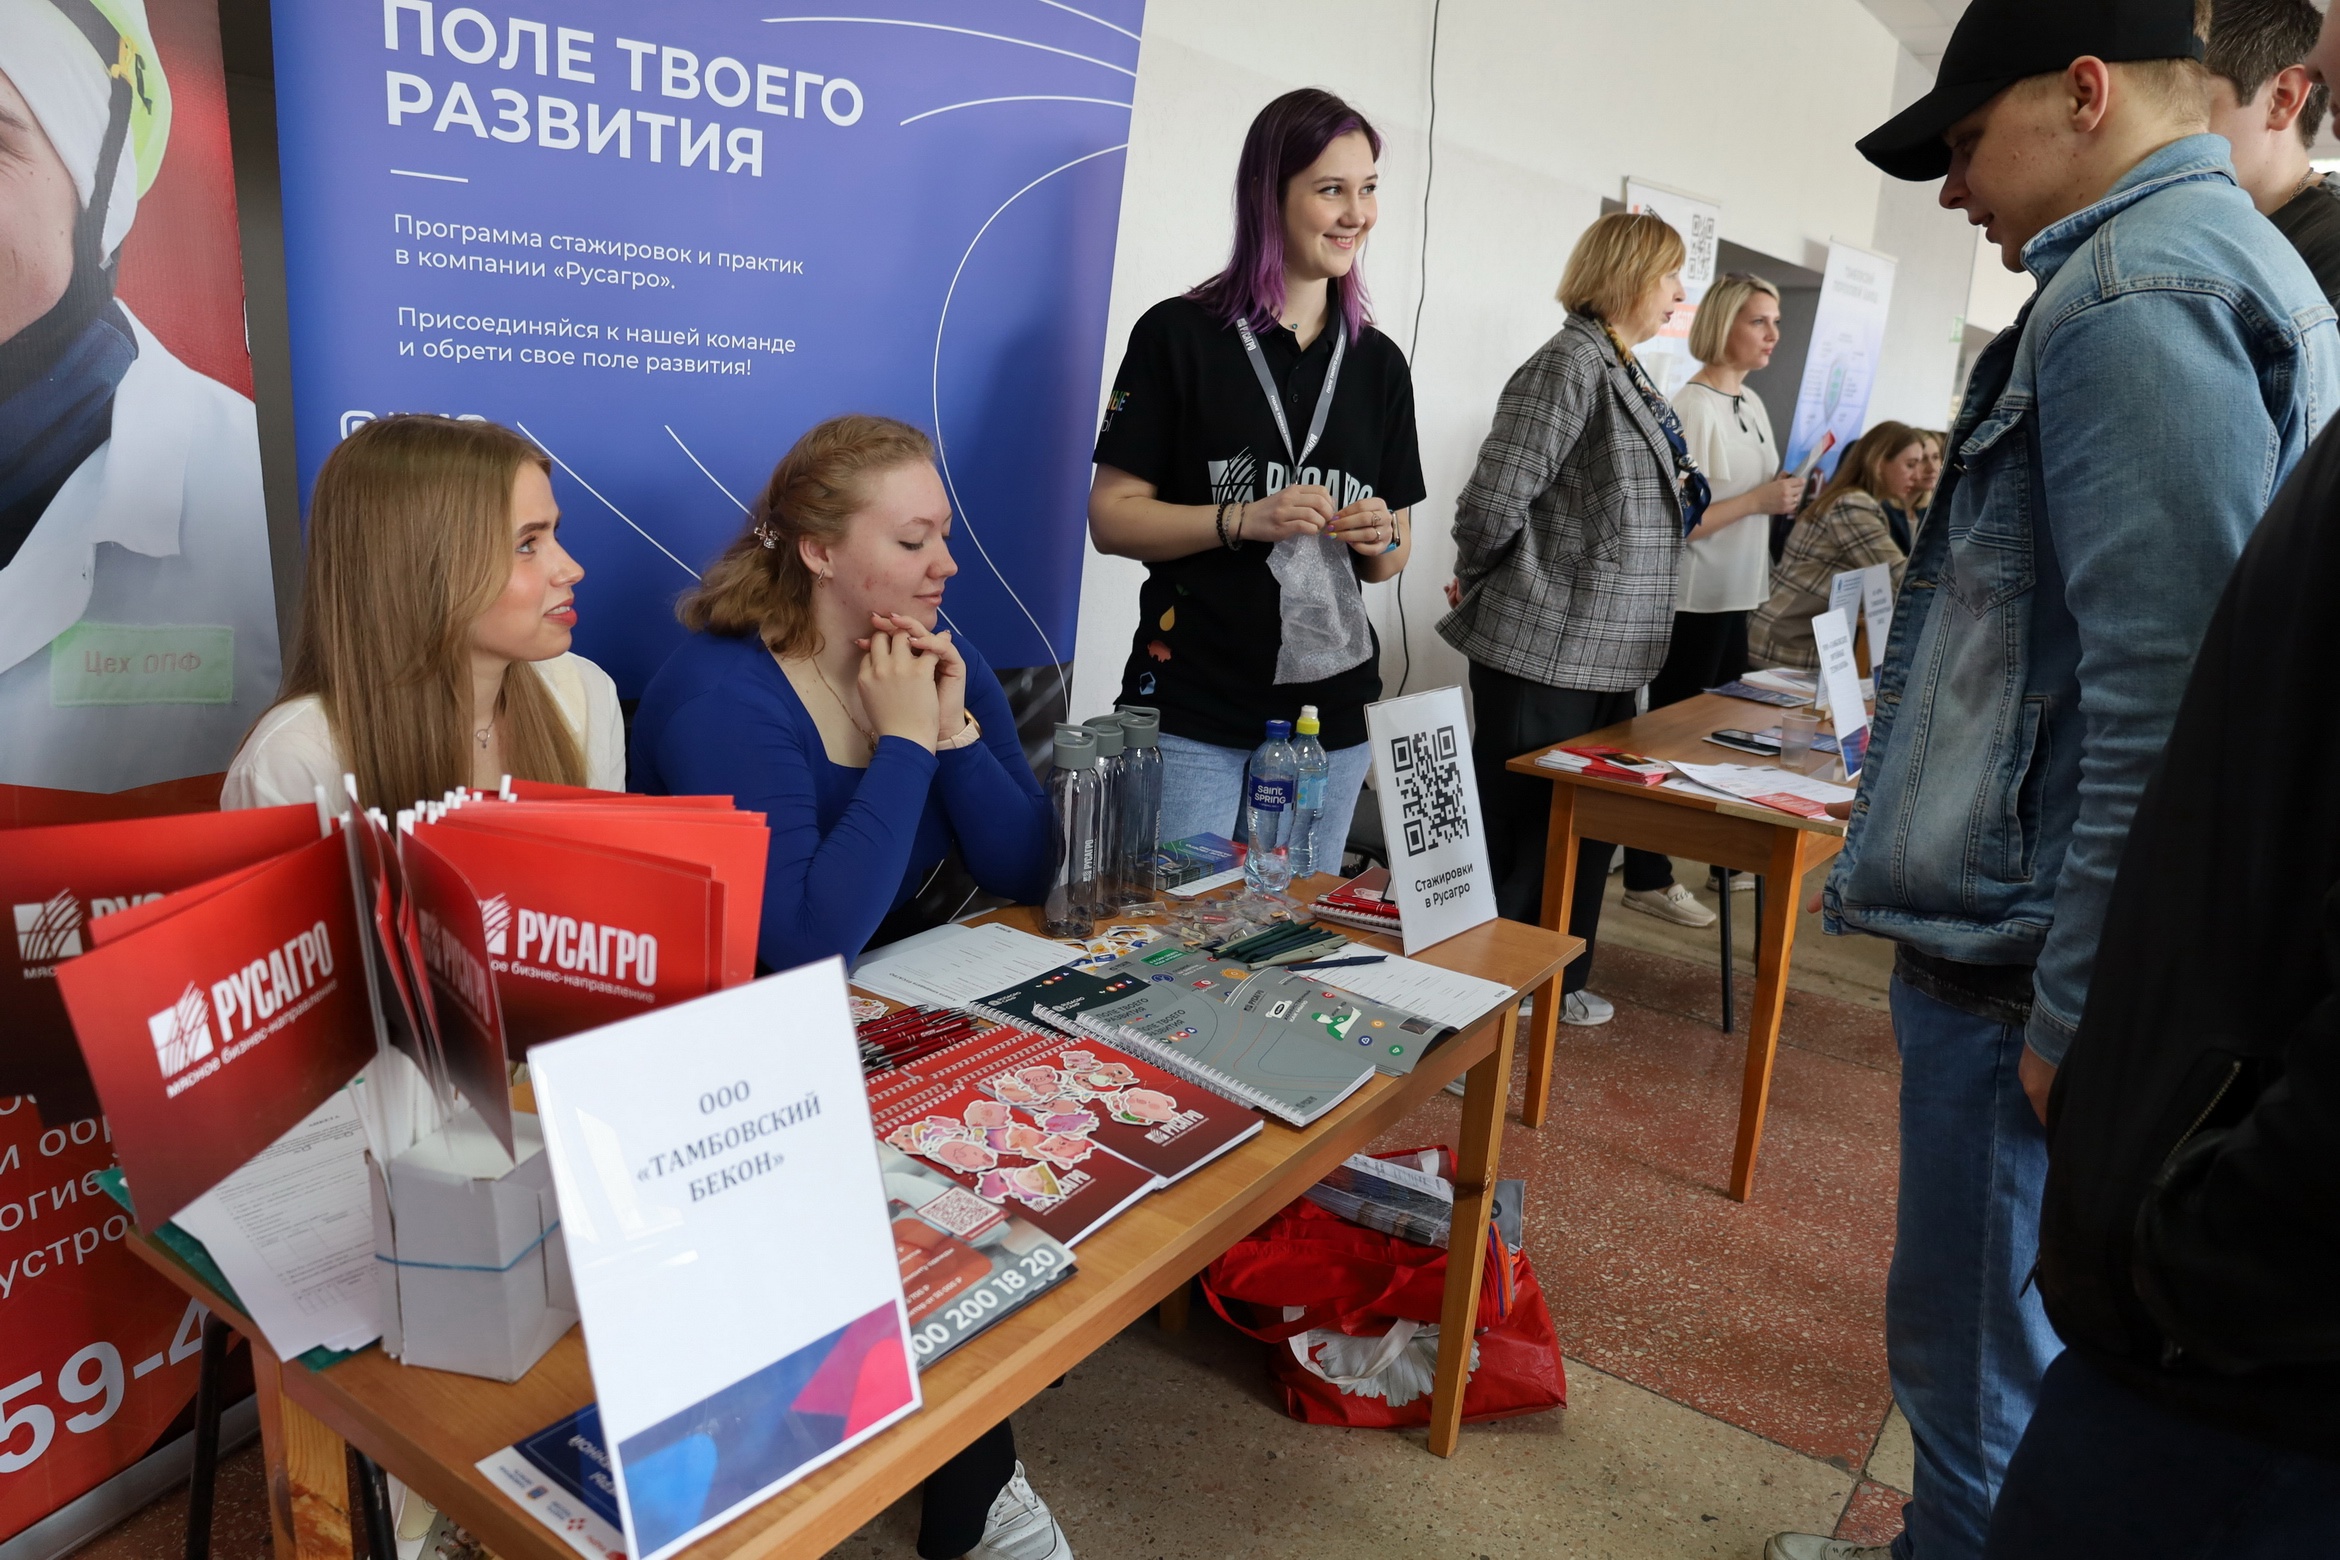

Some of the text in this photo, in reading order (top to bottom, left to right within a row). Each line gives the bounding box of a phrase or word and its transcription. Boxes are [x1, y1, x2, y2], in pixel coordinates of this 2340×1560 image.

[384, 0, 864, 127] ПОЛЕ ТВОЕГО
[385, 70, 763, 178] РАЗВИТИЯ
[394, 213, 804, 276] Программа стажировок и практик
[395, 249, 676, 290] в компании «Русагро».
[398, 306, 796, 355] Присоединяйся к нашей команде
[399, 338, 752, 377] и обрети свое поле развития!
[85, 650, 201, 677] Цех ОПФ
[1414, 863, 1474, 893] Стажировки
[1425, 883, 1471, 908] в Русагро
[517, 908, 658, 988] РУСАГРО
[211, 920, 335, 1043] РУСАГРО
[699, 1080, 750, 1116] ООО
[637, 1091, 822, 1183] «ТАМБОВСКИЙ
[688, 1151, 785, 1203] БЕКОН»
[913, 1248, 1057, 1357] 00 200 18 20
